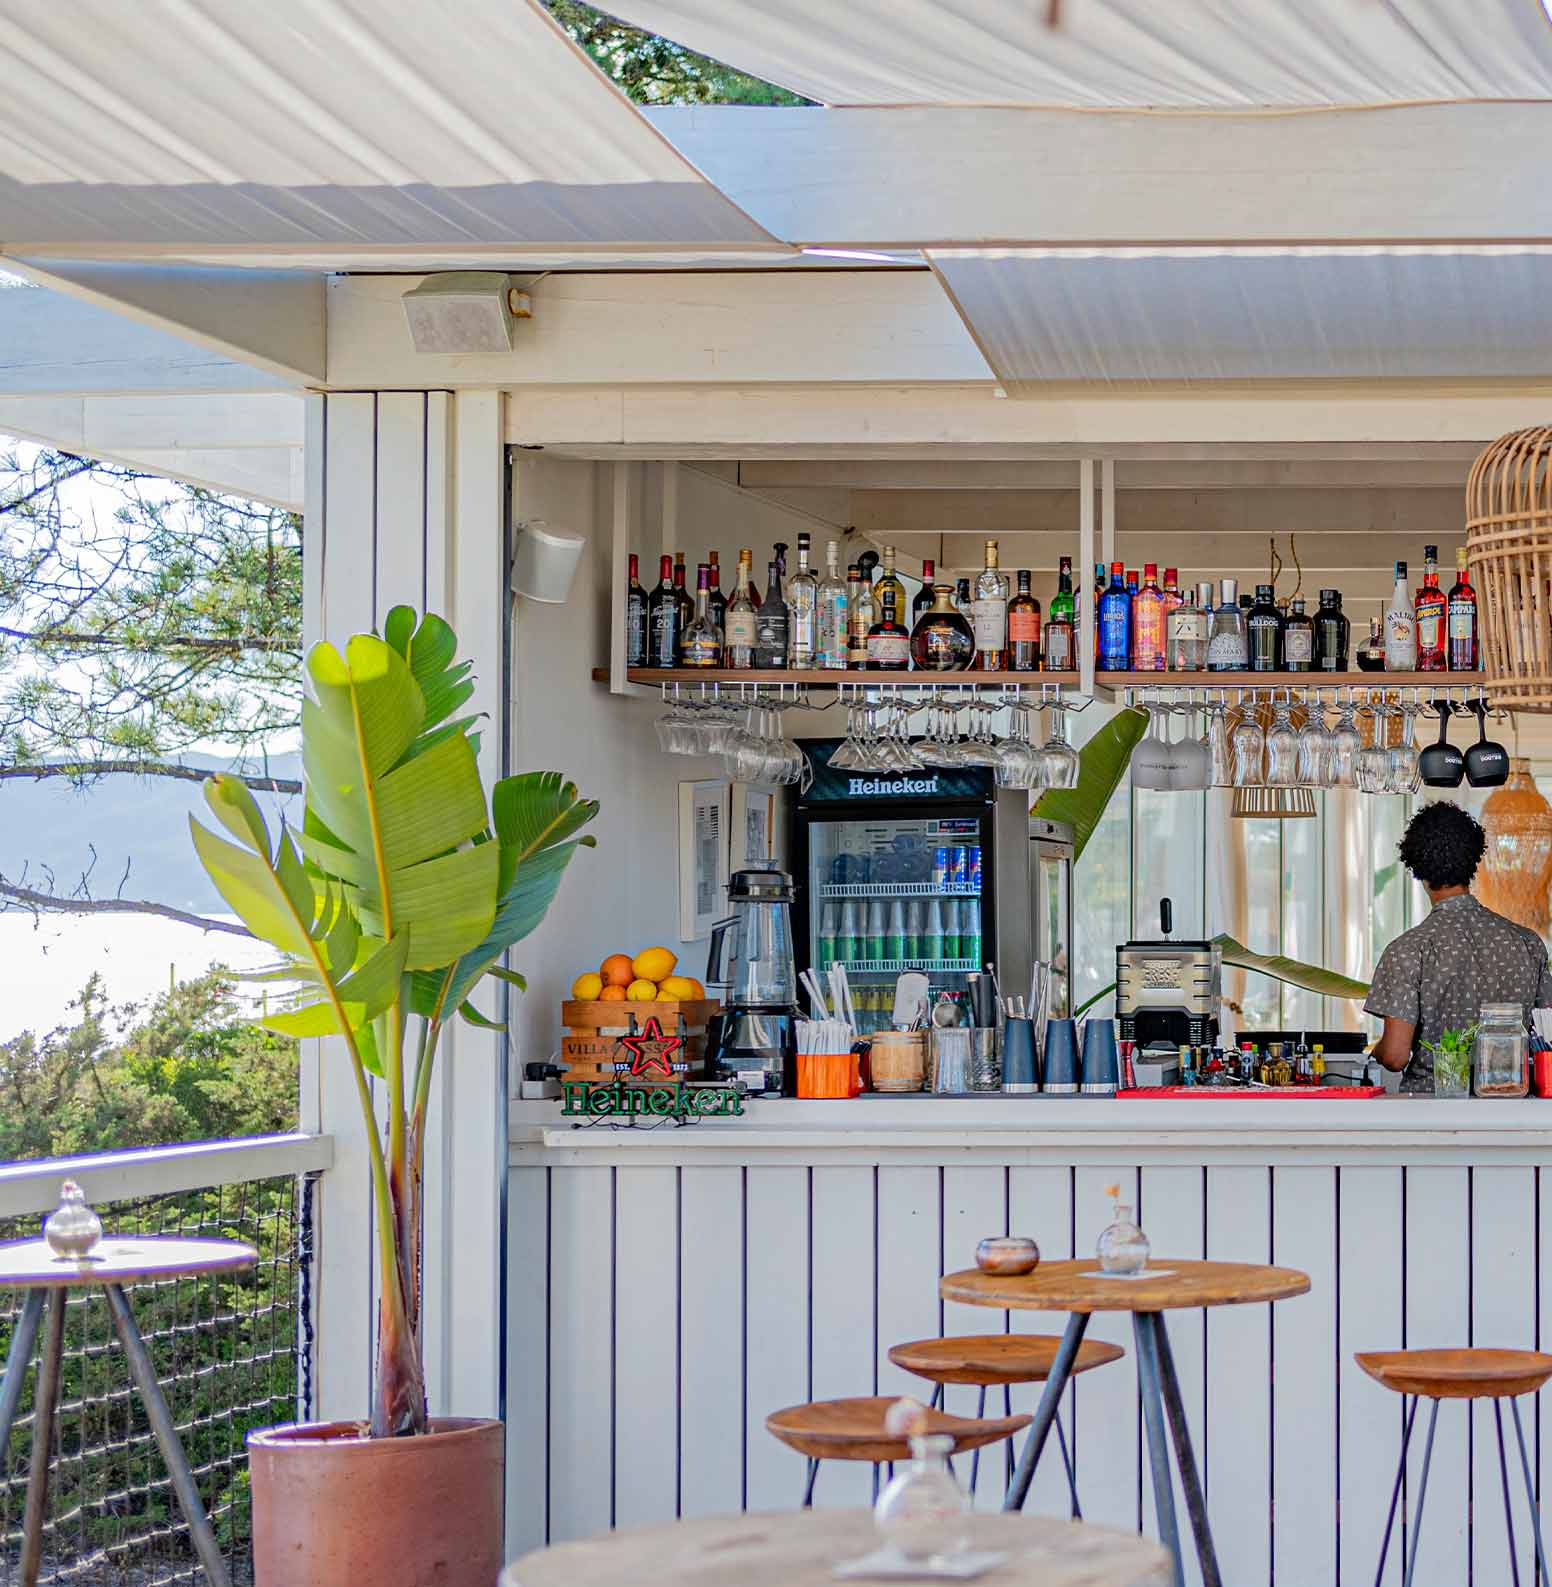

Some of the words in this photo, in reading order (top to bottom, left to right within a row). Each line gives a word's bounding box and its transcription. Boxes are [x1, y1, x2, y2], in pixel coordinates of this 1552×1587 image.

[849, 776, 938, 795] Heineken
[568, 1044, 607, 1054] VILLA
[561, 1082, 745, 1116] Heineken
